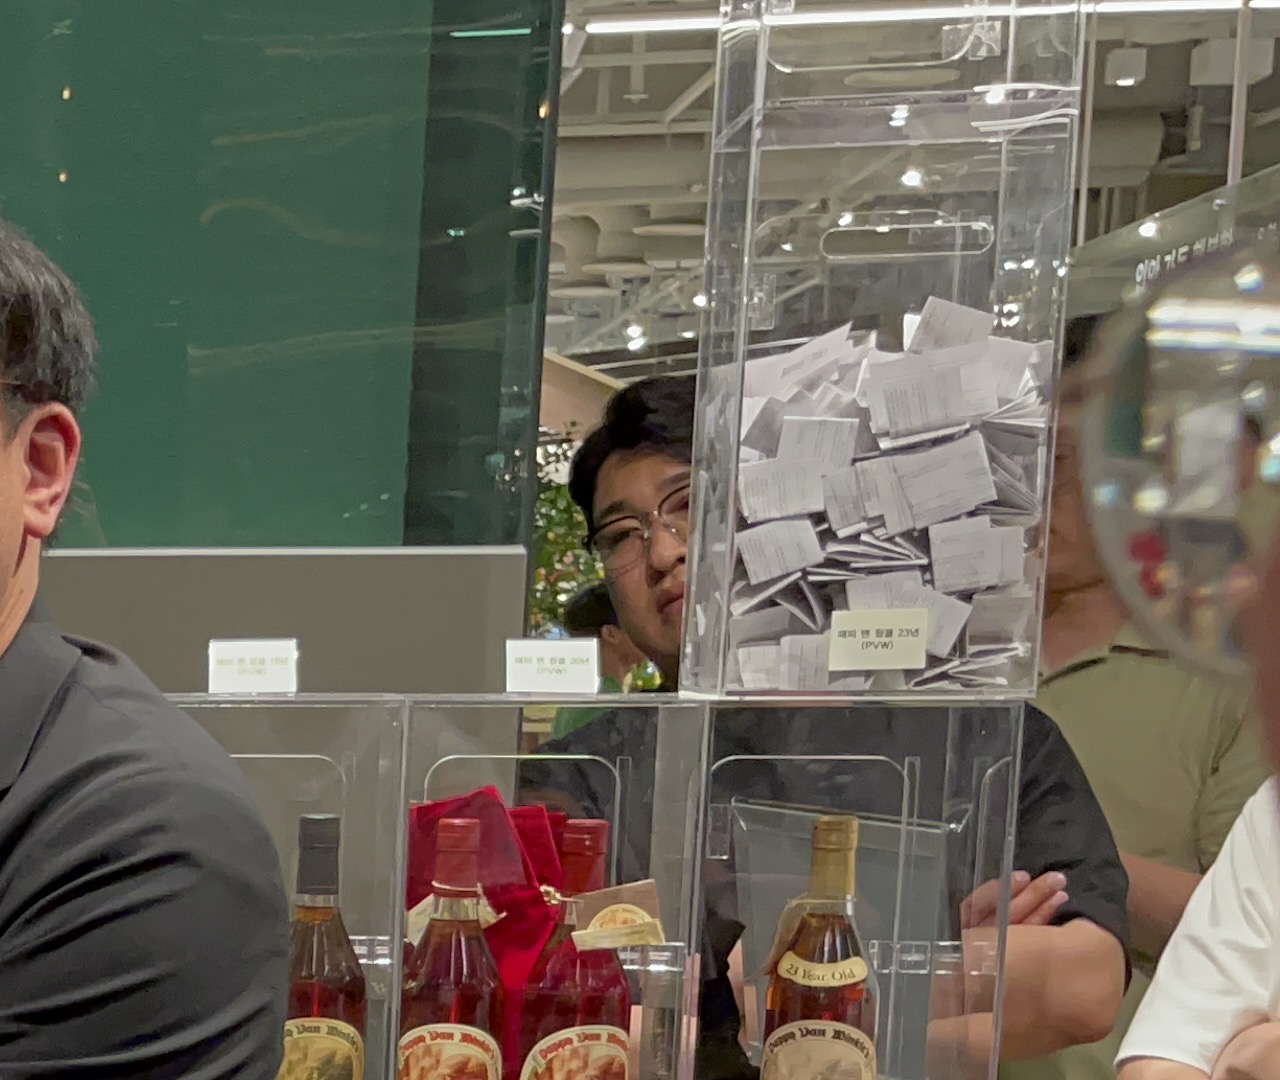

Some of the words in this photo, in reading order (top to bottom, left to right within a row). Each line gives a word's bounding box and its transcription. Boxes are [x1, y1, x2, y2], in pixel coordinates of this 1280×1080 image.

[861, 641, 893, 650] (PVW)
[801, 968, 828, 981] Year
[831, 967, 856, 982] Old
